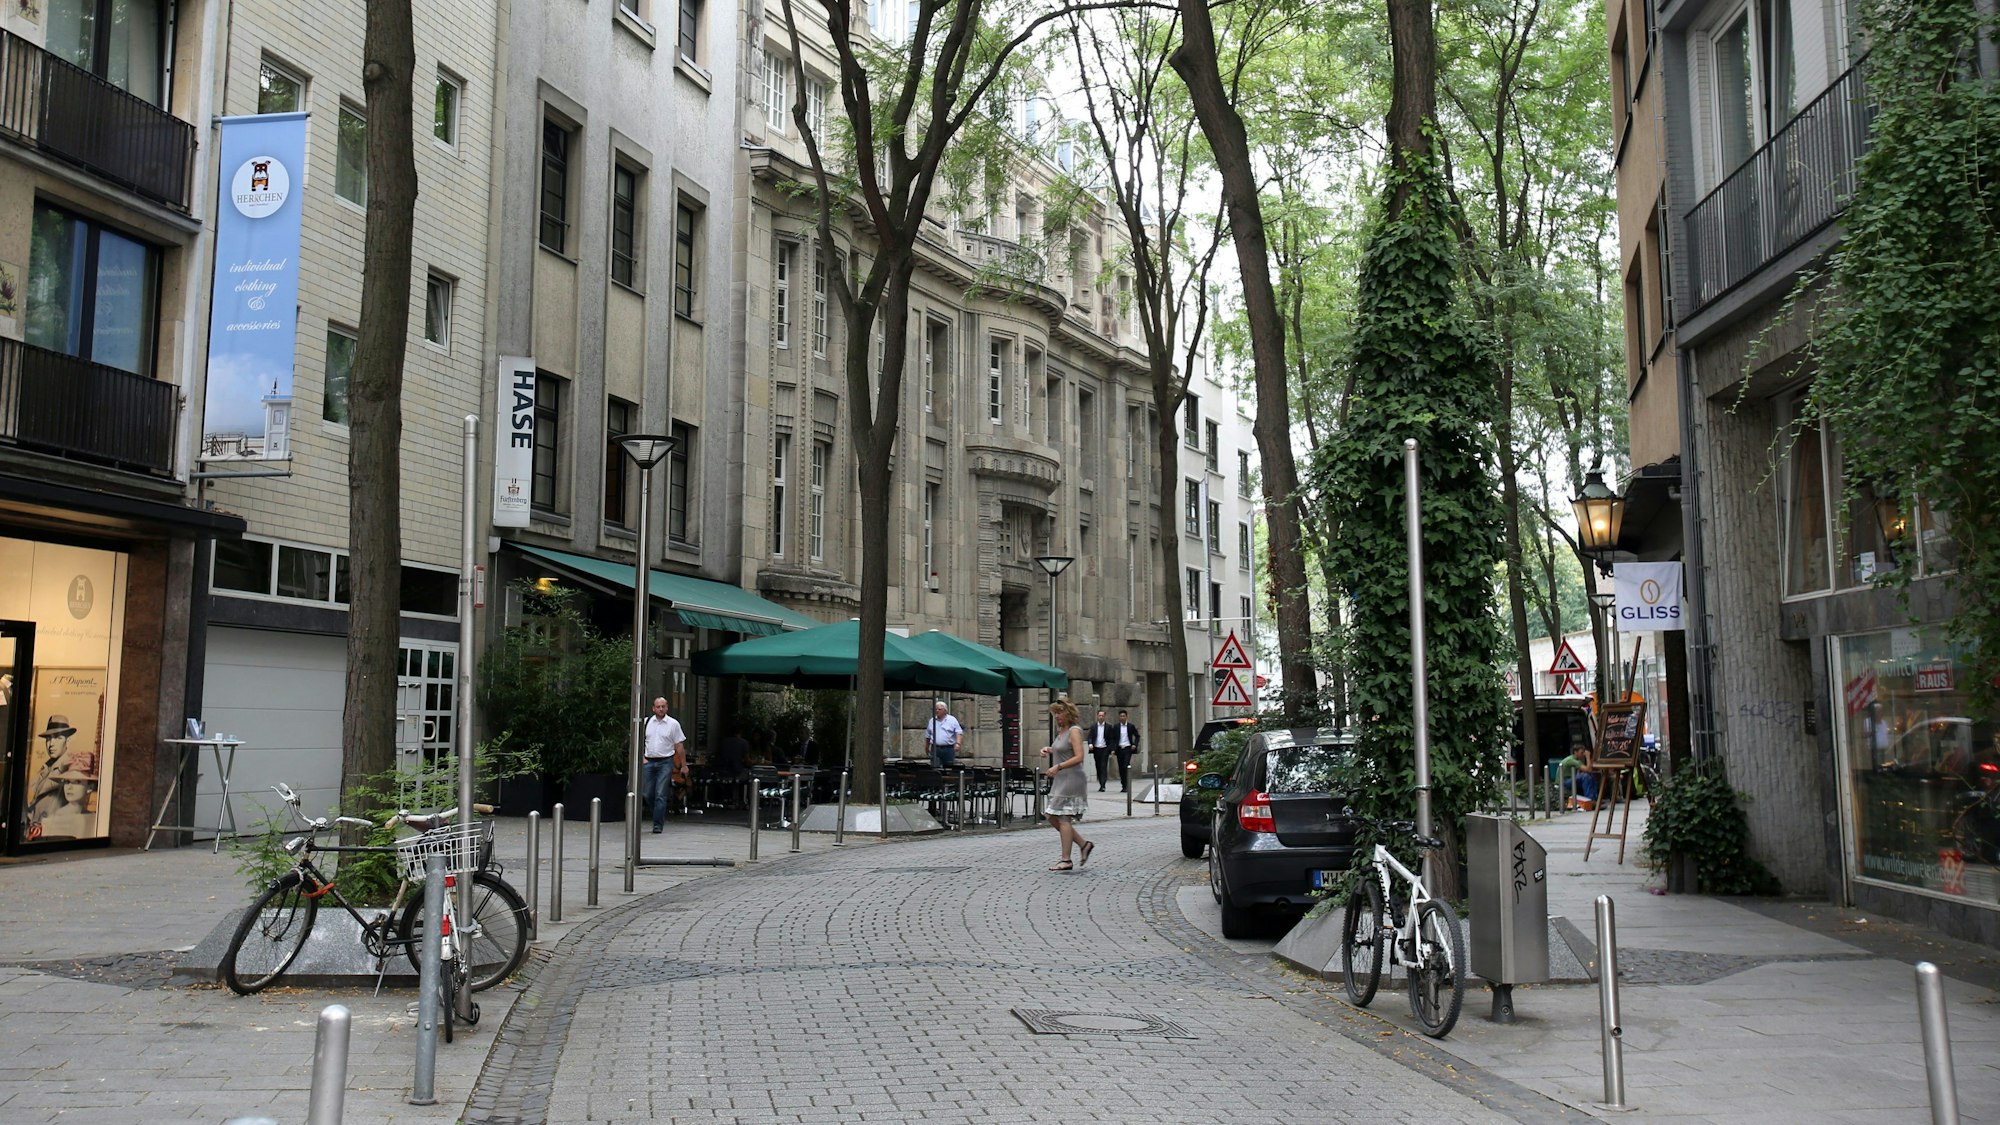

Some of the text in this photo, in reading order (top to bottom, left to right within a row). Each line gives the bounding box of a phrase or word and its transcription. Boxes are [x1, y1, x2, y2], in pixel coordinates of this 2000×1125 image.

[236, 192, 283, 204] HERRCHEN
[229, 257, 287, 273] individual
[234, 278, 277, 297] clothing
[247, 295, 266, 311] &
[226, 319, 281, 332] accessories
[511, 370, 534, 449] HASE
[1621, 605, 1680, 619] GLISS
[1919, 672, 1948, 689] RAUS
